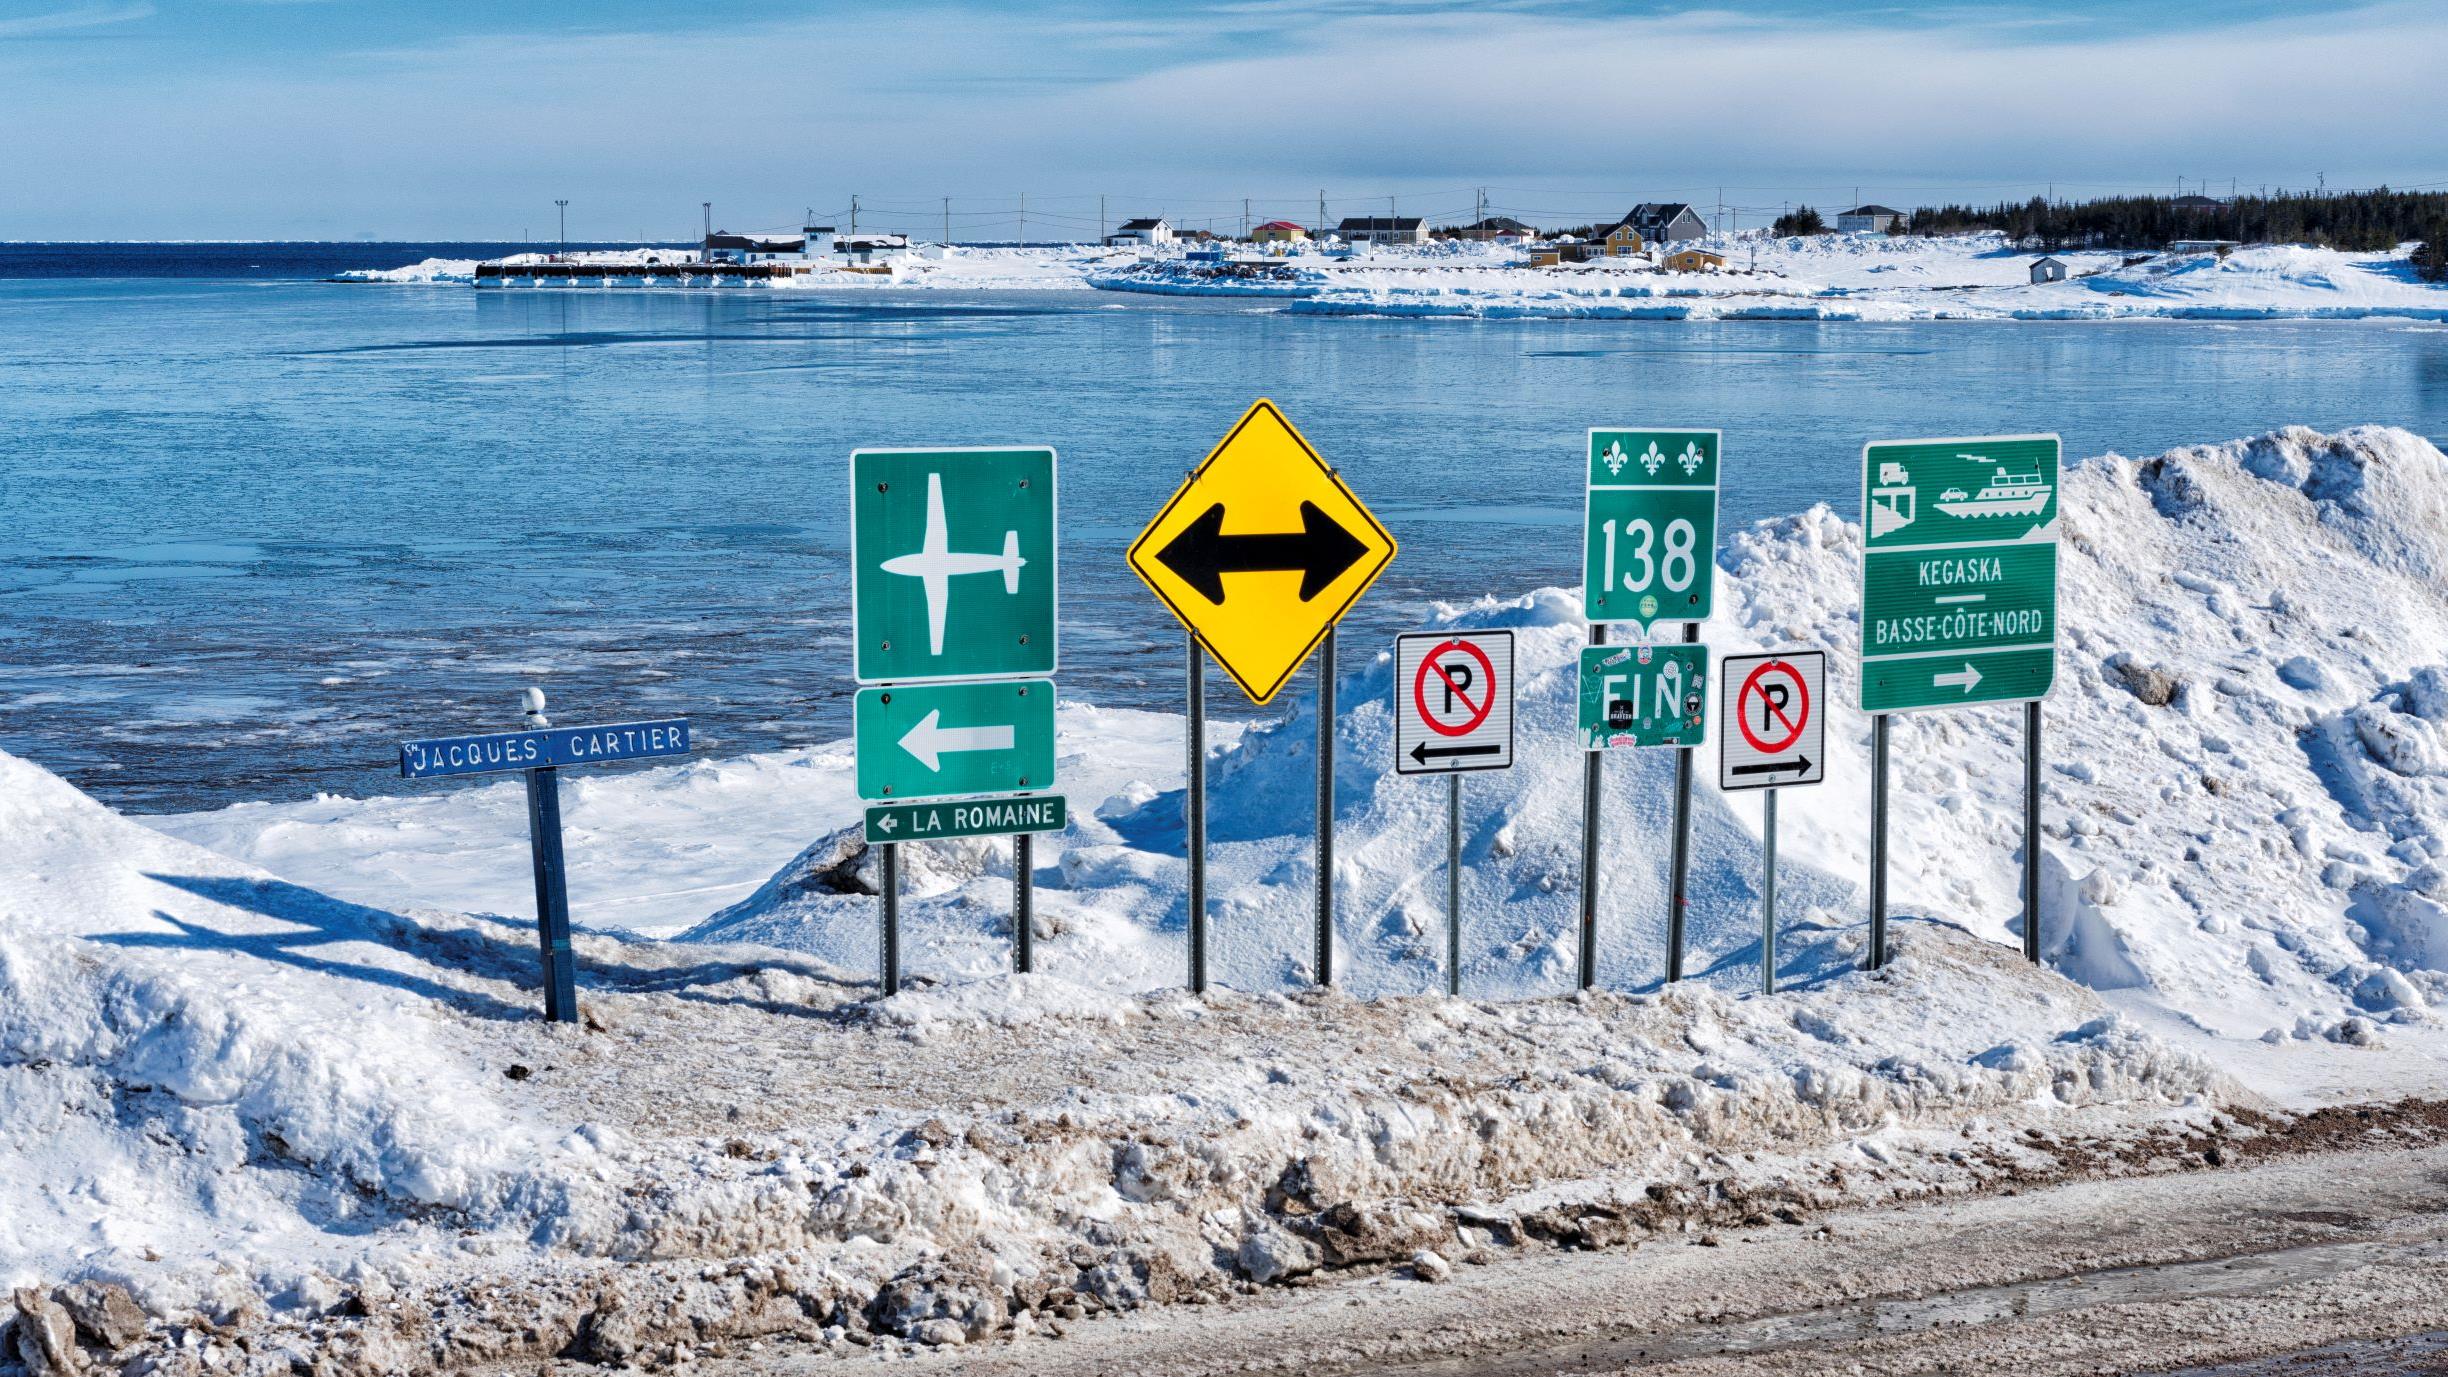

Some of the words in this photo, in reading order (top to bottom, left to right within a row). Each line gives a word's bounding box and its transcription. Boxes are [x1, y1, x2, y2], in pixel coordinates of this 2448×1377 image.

[1602, 518, 1696, 593] 138
[1919, 557, 2002, 586] KEGASKA
[1876, 607, 2043, 645] BASSE-CÔTE-NORD
[1444, 664, 1473, 714] P
[1602, 673, 1683, 722] FIN
[1764, 684, 1790, 732] P
[413, 739, 537, 771] JACQUES
[570, 726, 683, 757] CARTIER
[913, 810, 942, 833] LA
[955, 802, 1055, 830] ROMAINE
